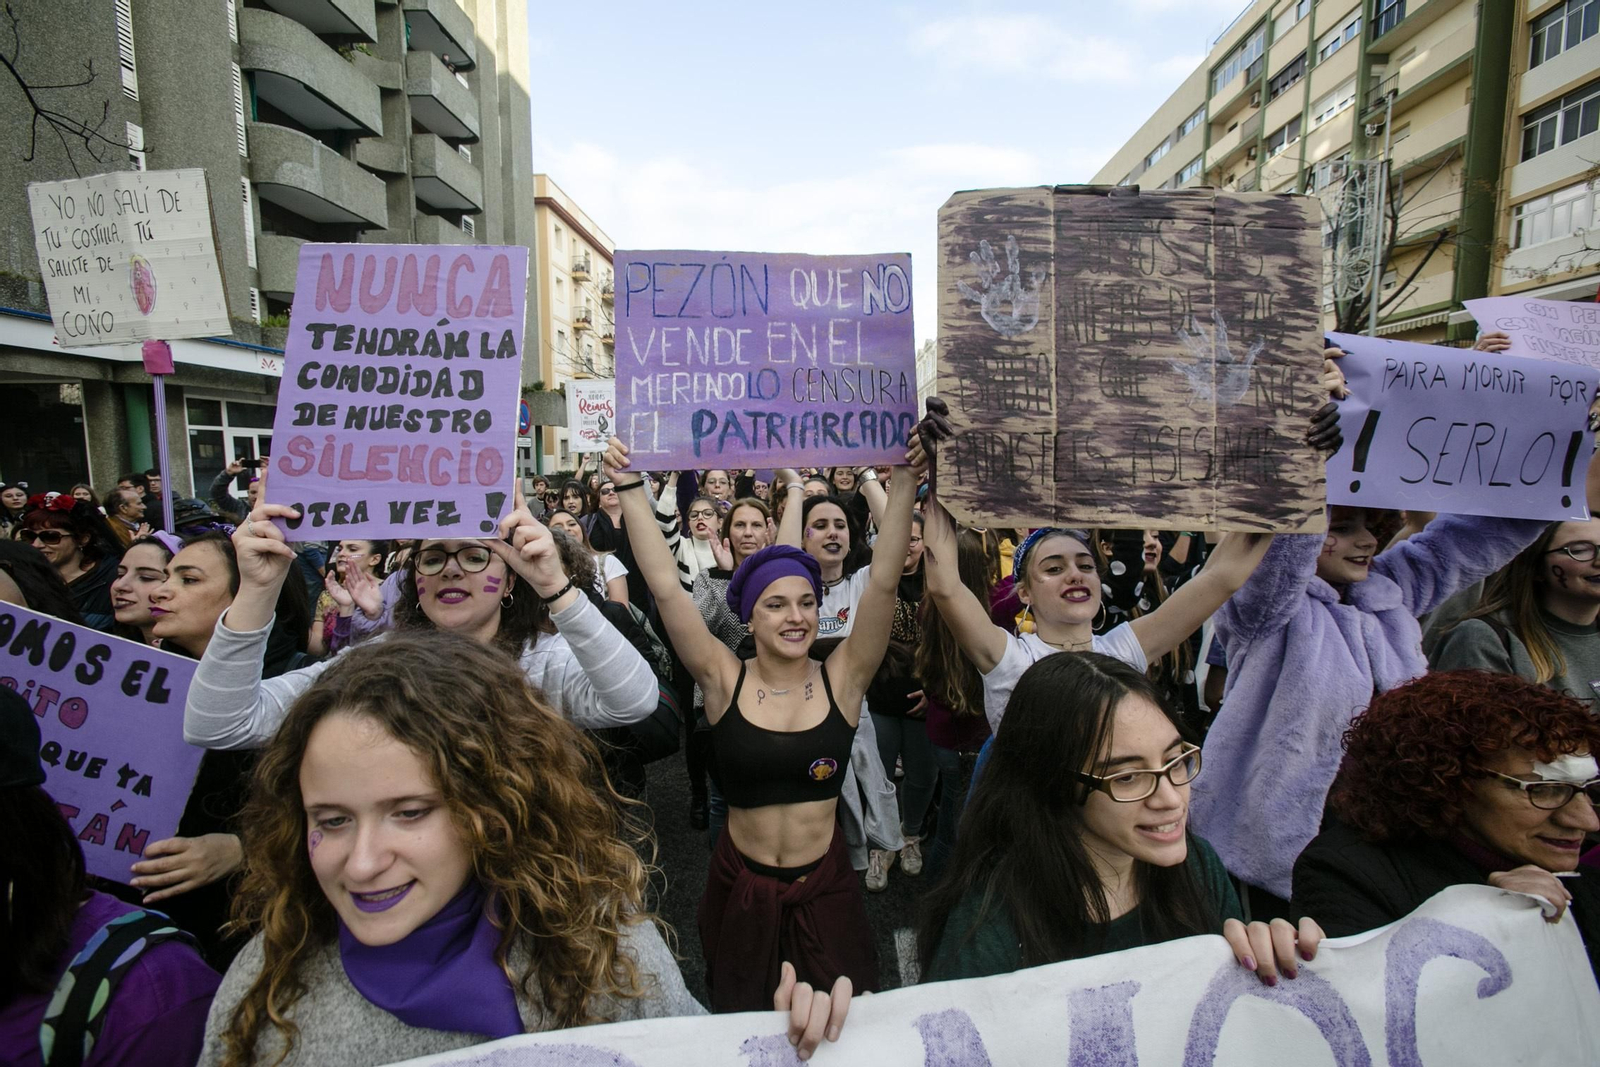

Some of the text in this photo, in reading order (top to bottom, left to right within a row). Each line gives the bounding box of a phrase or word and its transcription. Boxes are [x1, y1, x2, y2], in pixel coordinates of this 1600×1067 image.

[48, 187, 183, 220] YO NO SALÍ DE
[42, 226, 61, 251] TU
[135, 219, 154, 244] TÚ
[97, 256, 115, 273] DE
[314, 253, 514, 319] NUNCA
[625, 256, 912, 319] PEZÓN QUE NO
[62, 310, 115, 338] COÑO
[305, 317, 518, 360] TENDRÁN LA
[626, 318, 875, 367] VENDE EN EL
[1523, 334, 1600, 368] MUJERE
[747, 367, 781, 401] LO
[791, 366, 909, 405] CENSURA
[1382, 358, 1588, 406] PARA MORIR POR
[292, 402, 493, 434] DE NUESTRO
[579, 397, 614, 419] Reinas
[629, 408, 916, 459] EL PATRIARCADO
[285, 499, 370, 531] OTRA
[120, 659, 171, 704] EL
[40, 741, 154, 798] QUE YA
